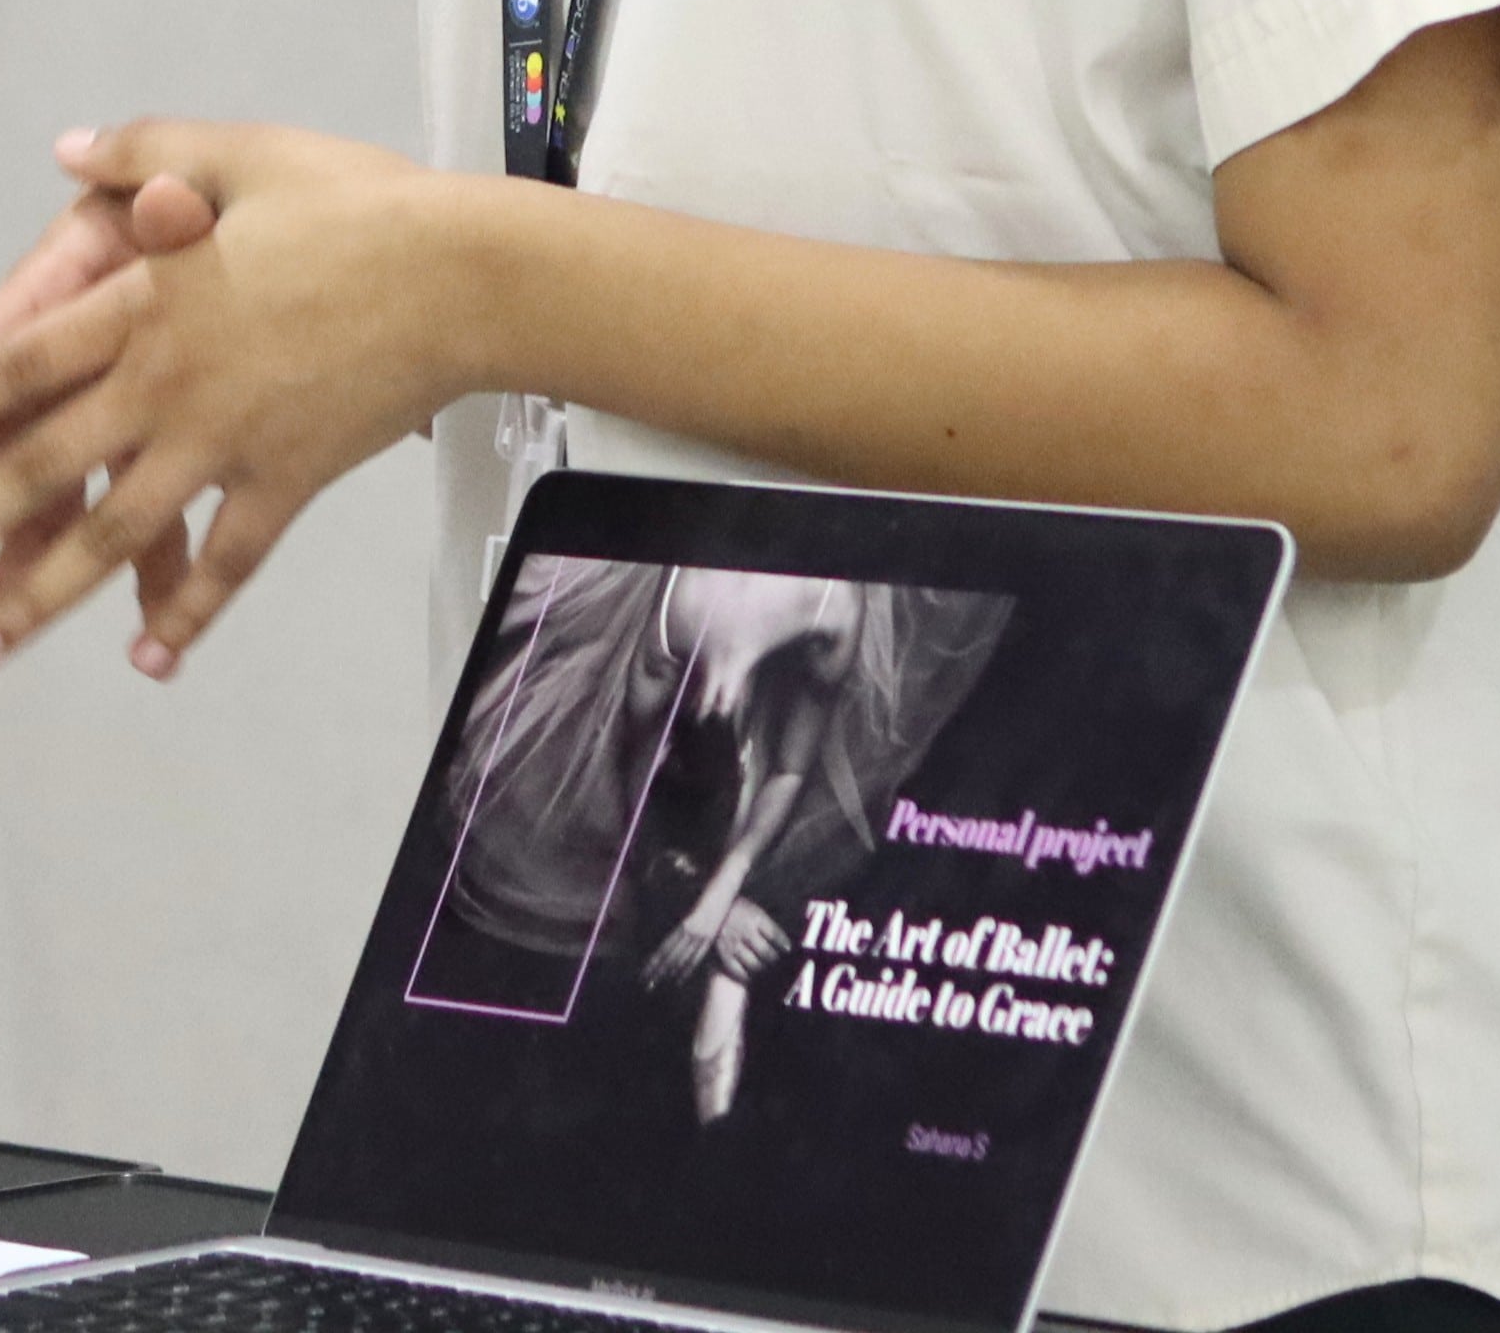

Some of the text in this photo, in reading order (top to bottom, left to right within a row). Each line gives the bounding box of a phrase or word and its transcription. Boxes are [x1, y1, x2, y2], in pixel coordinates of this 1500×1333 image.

[886, 797, 1153, 876] Personal project
[802, 898, 1115, 986] The Art of Ballet:
[783, 958, 1094, 1046] A Guide to Grace
